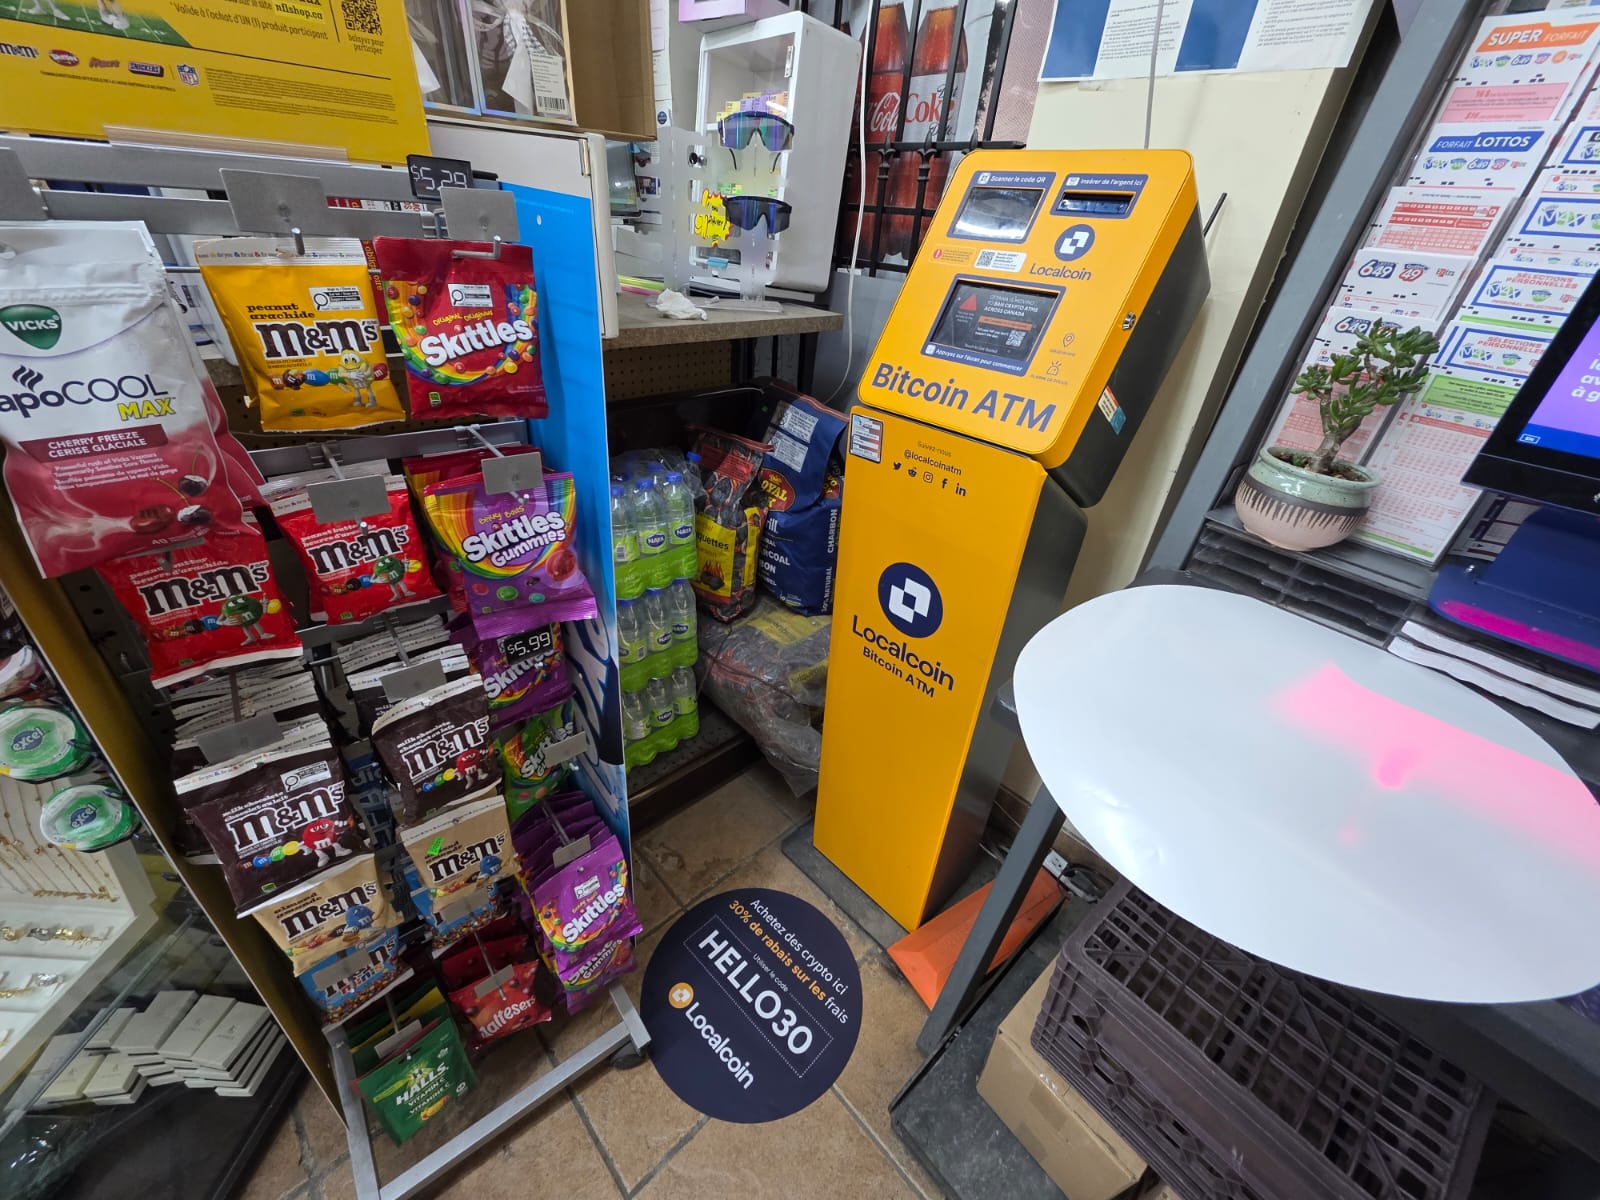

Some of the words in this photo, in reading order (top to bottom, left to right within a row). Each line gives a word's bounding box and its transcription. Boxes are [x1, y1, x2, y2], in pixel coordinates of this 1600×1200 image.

[276, 4, 323, 20] nflshop.ca
[1487, 29, 1543, 46] SUPER
[1544, 30, 1589, 42] FORFAIT
[1436, 140, 1473, 149] FORFAIT
[1474, 136, 1532, 148] LOTTOS
[1468, 159, 1490, 169] 649
[990, 175, 1013, 183] Scanner
[1029, 263, 1092, 281] Localcoin
[1359, 259, 1393, 278] 649
[1401, 268, 1423, 280] 49
[1506, 277, 1578, 290] PERSONNELLES
[246, 303, 299, 313] peanut
[250, 311, 315, 320] arachide
[1004, 309, 1025, 317] CANADA
[4, 318, 59, 332] VICKS
[420, 319, 533, 367] Skittles
[935, 349, 956, 359] Appuyez
[980, 357, 992, 365] pour
[992, 361, 1023, 371] commencer
[871, 362, 969, 411] Bitcoin
[972, 388, 1057, 433] ATM
[118, 398, 176, 421] MAX
[48, 437, 94, 450] CHERRY
[97, 431, 140, 444] FREEZE
[48, 446, 90, 458] CERISE
[92, 438, 148, 453] GLACIALE
[918, 441, 952, 458] Suivez-nous
[904, 450, 962, 475] @localcoinatm
[761, 479, 788, 502] OYAL
[462, 512, 565, 562] Skittles
[697, 534, 729, 551] quettes
[828, 508, 838, 554] CHARBON
[491, 529, 566, 567] Gummies
[172, 561, 229, 576] d'arachide
[507, 631, 551, 656] $5.99
[852, 614, 954, 691] Localcoin
[863, 646, 903, 680] Bitcoin
[905, 673, 935, 698] ATM
[12, 727, 44, 751] excel
[243, 791, 284, 809] chocolate
[71, 803, 97, 829] excel
[274, 892, 317, 914] almond
[276, 896, 322, 919] amande
[562, 883, 625, 943] Skittles
[750, 899, 786, 935] Achetez
[784, 932, 803, 952] des
[801, 949, 833, 982] crypto
[832, 977, 849, 996] ici
[729, 900, 753, 924] 30%
[749, 921, 764, 936] de
[761, 934, 793, 967] rabais
[791, 965, 811, 983] sur
[808, 980, 827, 1001] les
[824, 996, 849, 1024] frais
[753, 953, 771, 973] Utiliser
[774, 977, 789, 993] code
[698, 929, 813, 1055] HELLO30
[684, 1001, 755, 1090] Localcoin
[396, 1062, 447, 1106] HALLS
[408, 1082, 439, 1106] VITAMIN
[409, 1087, 444, 1114] VITAMINE
